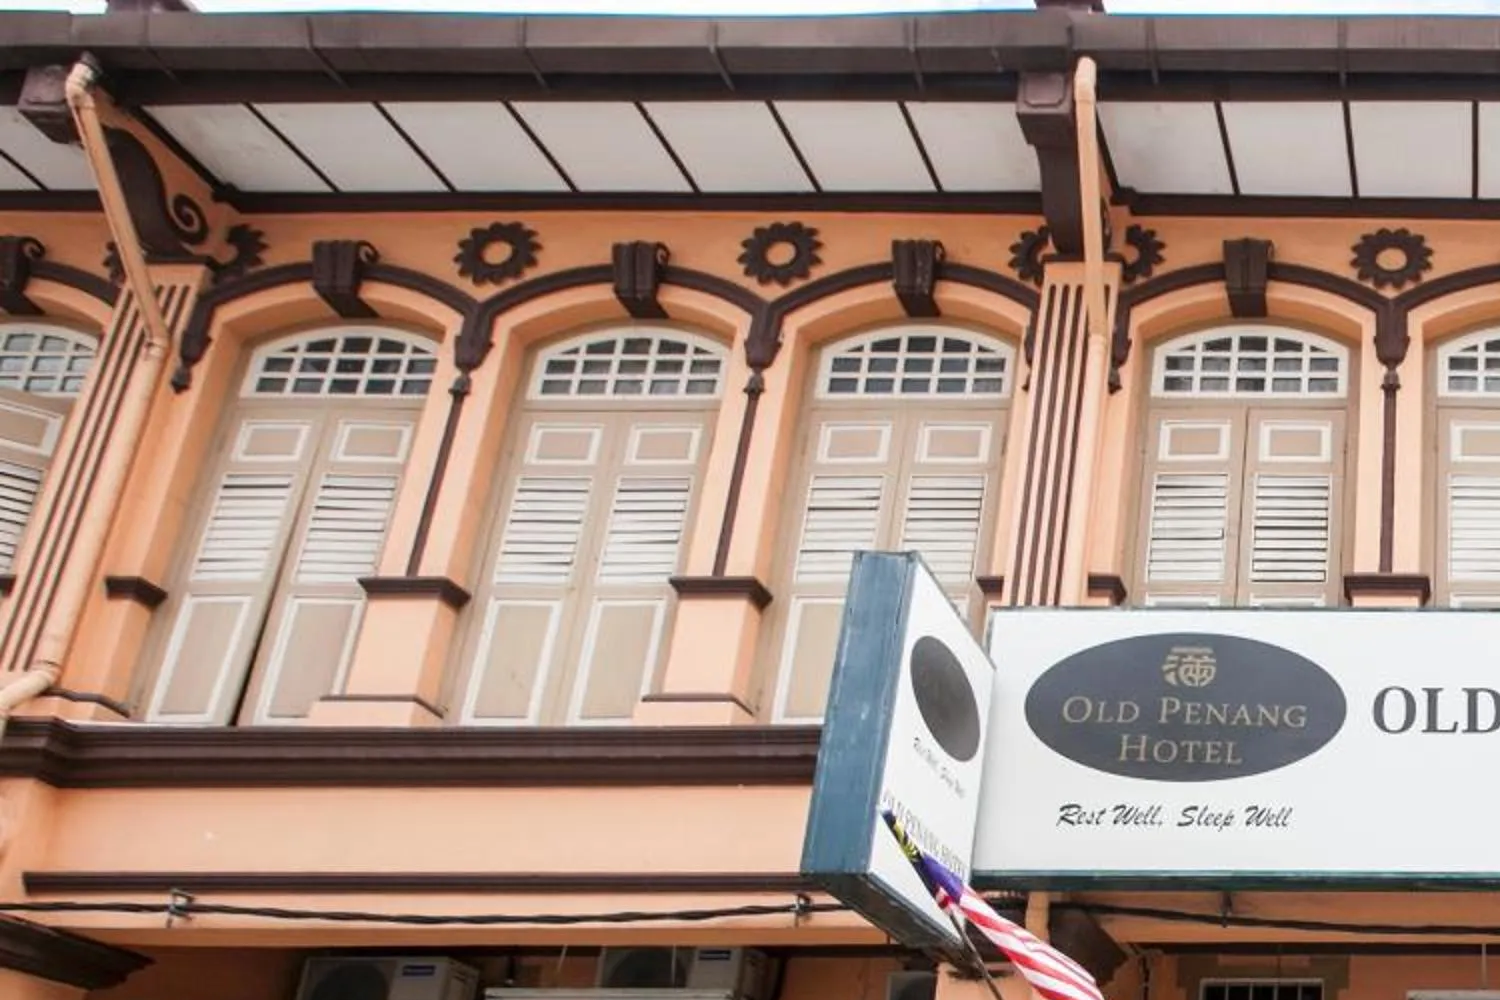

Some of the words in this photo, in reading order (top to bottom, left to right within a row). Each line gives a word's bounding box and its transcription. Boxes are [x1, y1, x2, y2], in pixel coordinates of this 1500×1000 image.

[1062, 695, 1141, 724] OLD
[1158, 696, 1308, 728] PENANG
[1118, 733, 1243, 765] HOTEL
[1055, 803, 1107, 827] Rest
[1112, 803, 1163, 828] Well,
[1176, 803, 1235, 833] Sleep
[1244, 804, 1294, 828] Well
